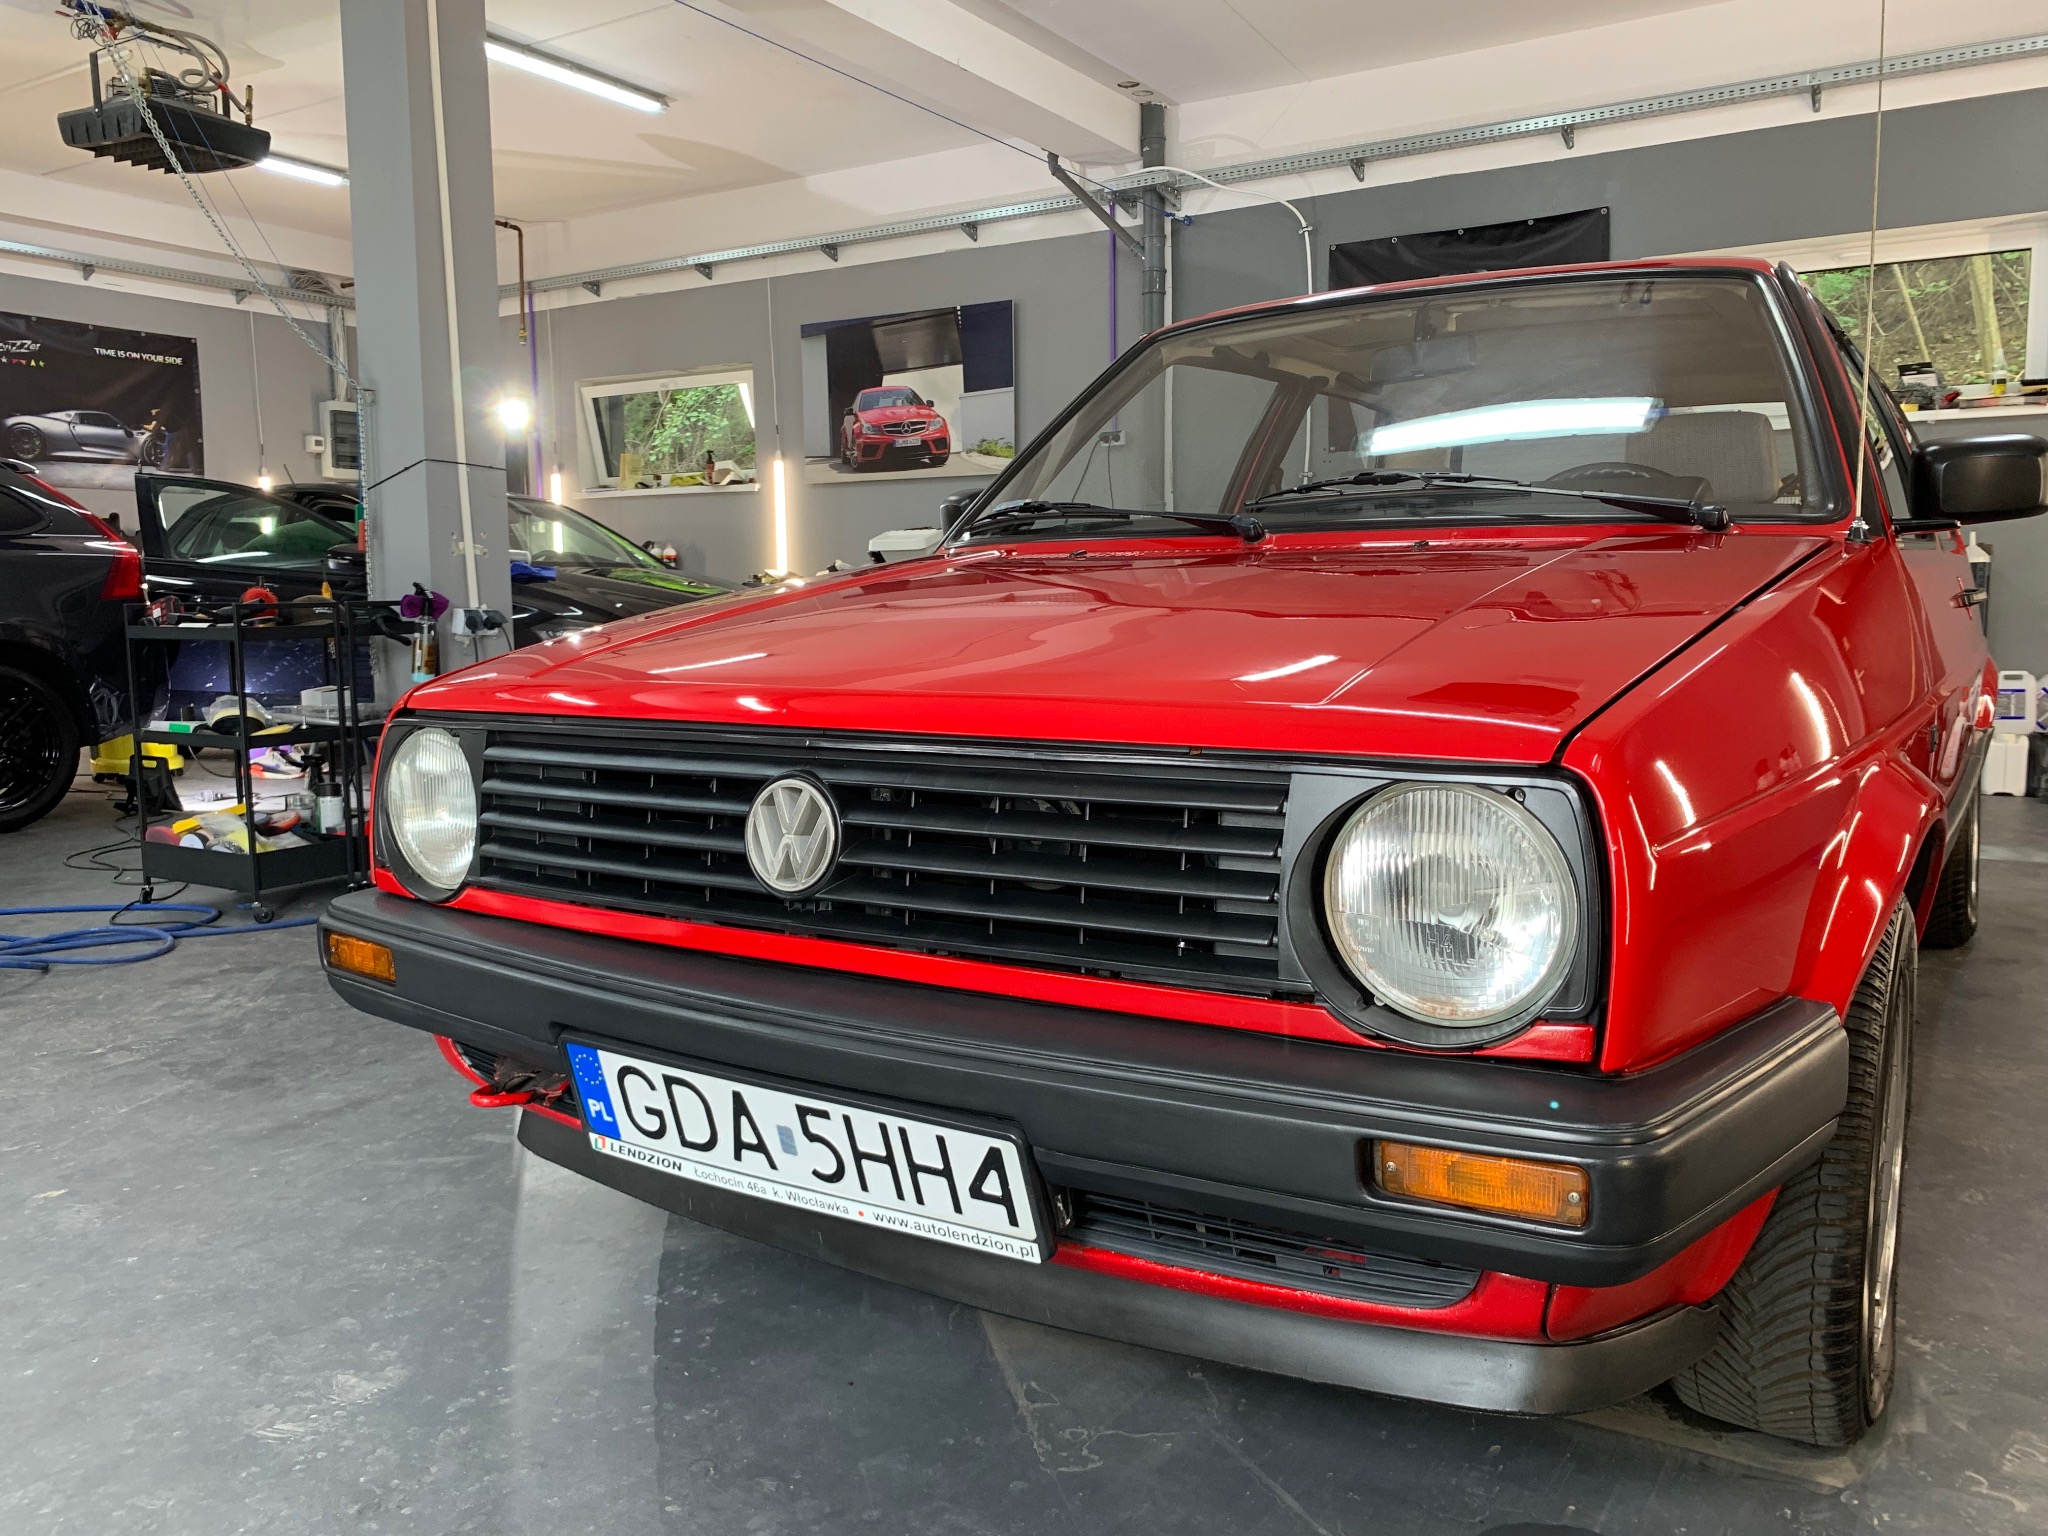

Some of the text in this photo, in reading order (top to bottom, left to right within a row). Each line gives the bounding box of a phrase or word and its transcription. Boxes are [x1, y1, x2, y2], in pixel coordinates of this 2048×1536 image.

[94, 347, 183, 366] TIME IS ON YOUR SIDE
[588, 1098, 614, 1122] PL
[617, 1065, 1020, 1228] GDA 5HH4
[610, 1142, 1035, 1258] LENDZION Łochocin 46a k. Włocławka www.autolendzion.pl
